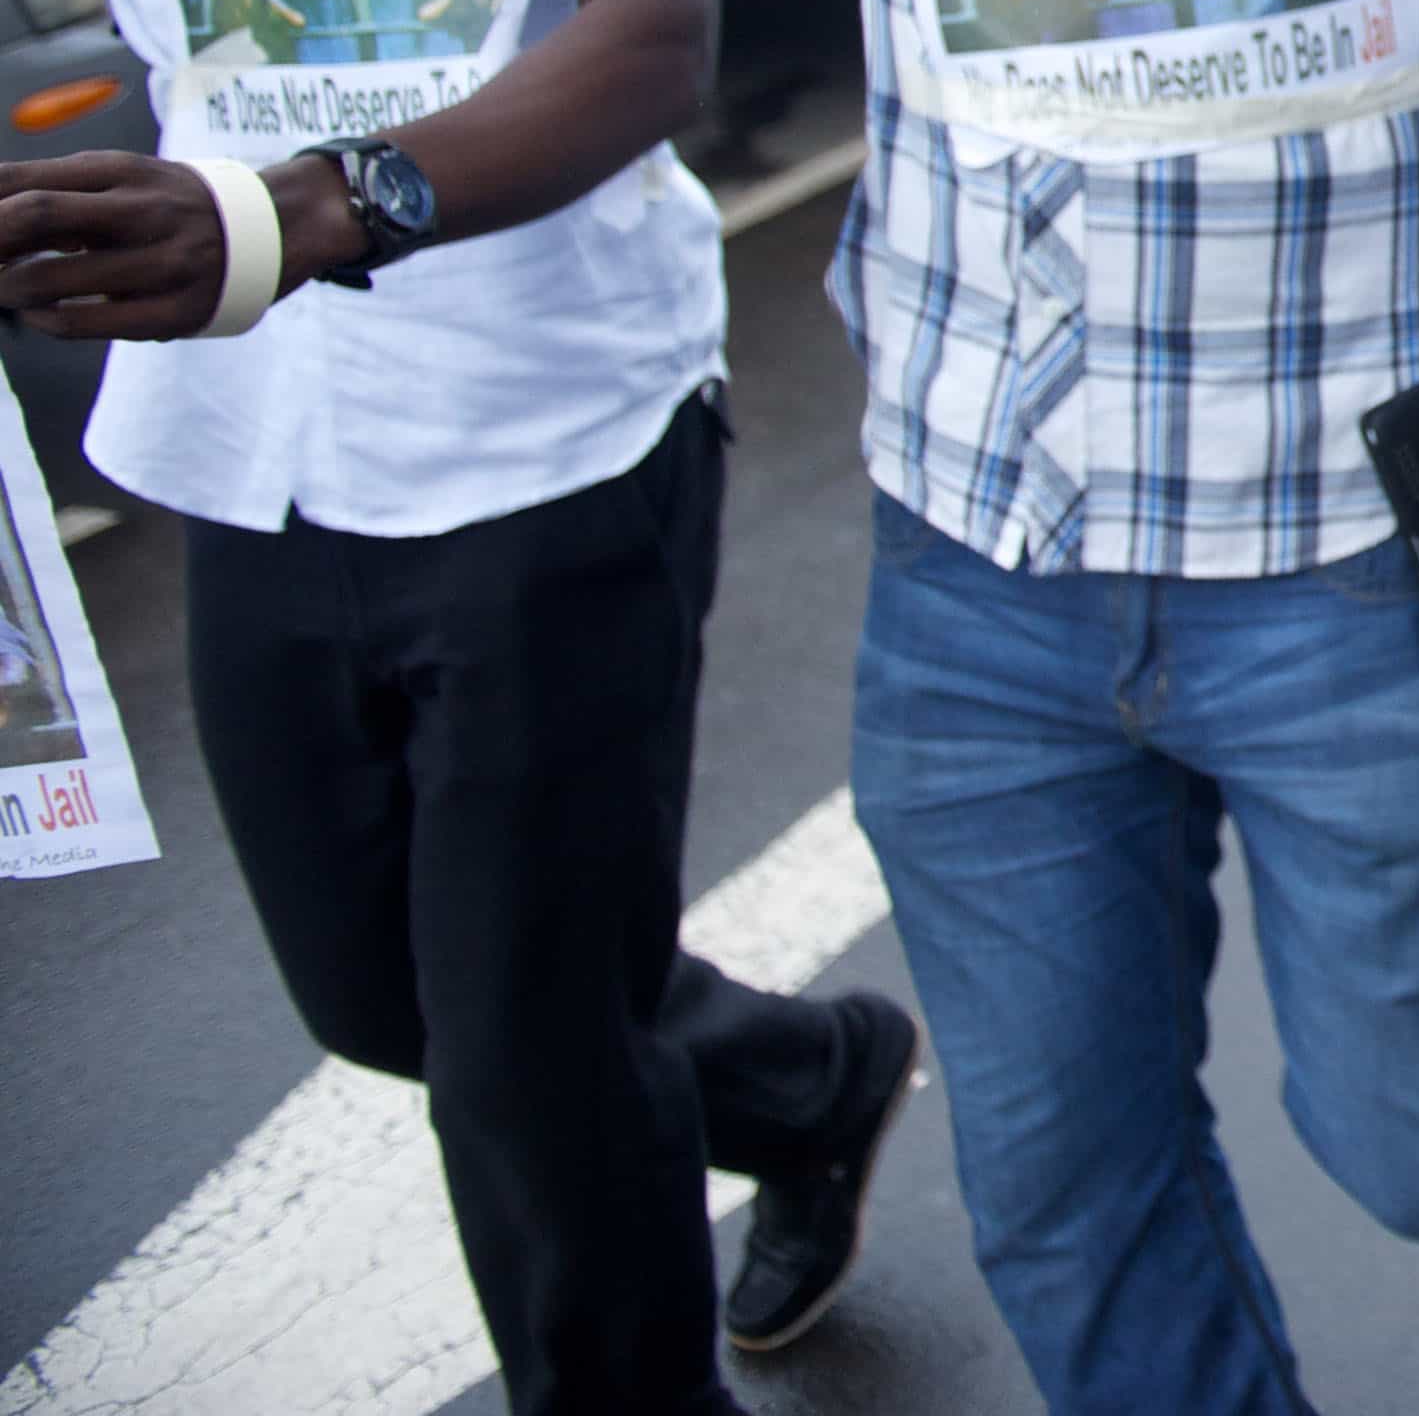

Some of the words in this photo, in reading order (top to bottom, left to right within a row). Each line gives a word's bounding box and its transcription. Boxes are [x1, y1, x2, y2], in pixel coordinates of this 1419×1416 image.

[1131, 46, 1250, 106] Deserve
[1251, 29, 1288, 89] To
[1291, 18, 1327, 81] Be
[1329, 12, 1356, 72] In
[233, 72, 281, 134] Does
[280, 74, 324, 134] Not
[322, 75, 425, 135] Deserve
[38, 768, 99, 832] Jail
[30, 845, 97, 869] Media
